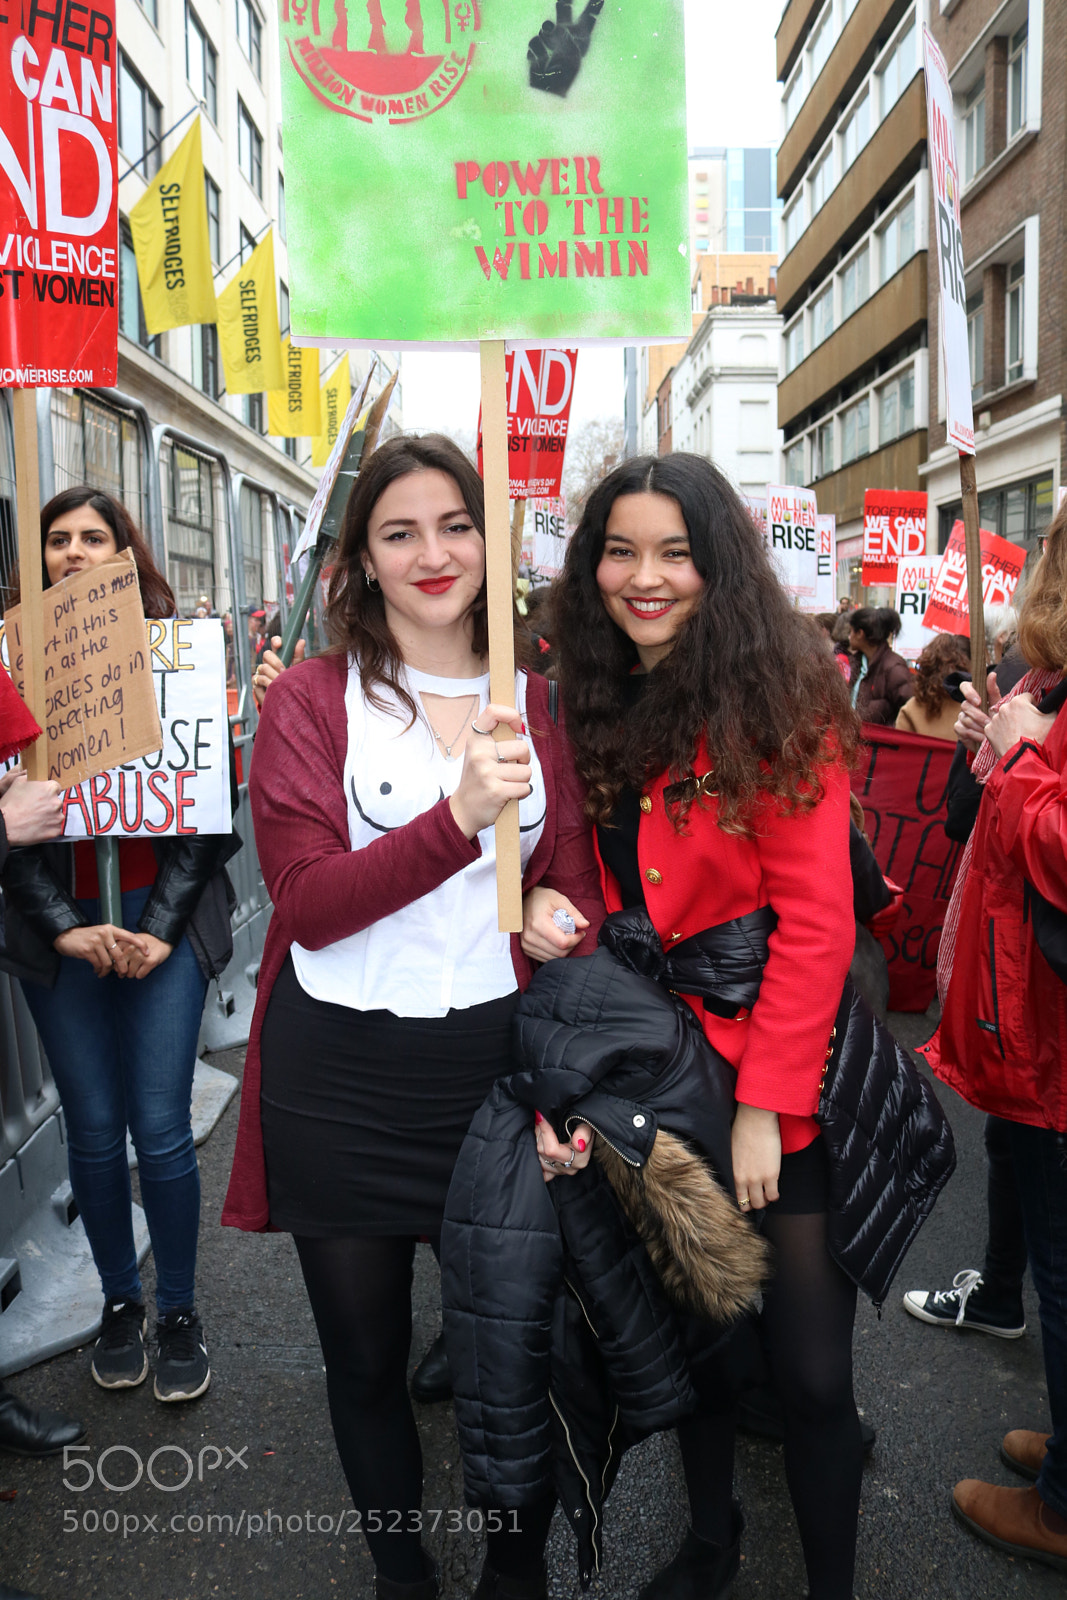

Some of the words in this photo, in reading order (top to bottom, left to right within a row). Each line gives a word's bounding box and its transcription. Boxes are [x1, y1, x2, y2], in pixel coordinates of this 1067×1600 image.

[0, 0, 112, 61] HER
[11, 35, 112, 123] CAN
[294, 36, 356, 106] MILLION
[360, 91, 430, 116] WOMEN
[428, 50, 467, 98] RISE
[455, 156, 605, 200] POWER
[159, 183, 186, 291] SELFRIDGES
[495, 200, 550, 238] TO
[566, 197, 650, 236] THE
[474, 240, 650, 282] WIMMIN
[239, 279, 262, 364] SELFRIDGES
[287, 343, 303, 414] SELFRIDGES
[505, 349, 573, 416] ND
[326, 387, 338, 447] SELFRIDGES
[516, 416, 568, 437] VIOLENCE
[534, 511, 566, 539] RISE
[865, 505, 927, 518] TOGETHER
[865, 514, 890, 531] WE
[893, 516, 926, 531] CAN
[771, 523, 816, 552] RISE
[863, 527, 925, 556] END
[863, 554, 886, 564] MALE
[982, 564, 1018, 592] CAN
[54, 597, 77, 627] put
[88, 583, 106, 602] as
[111, 570, 137, 594] much
[899, 592, 927, 615] RI
[930, 599, 968, 620] AGAINST
[932, 591, 960, 610] MALE
[64, 626, 78, 645] in
[82, 608, 118, 635] this
[61, 654, 76, 670] as
[80, 635, 109, 661] the
[46, 673, 94, 719] ORIES
[101, 664, 121, 688] do
[129, 650, 144, 671] in
[47, 686, 124, 741] otecting
[61, 770, 199, 835] ABUSE
